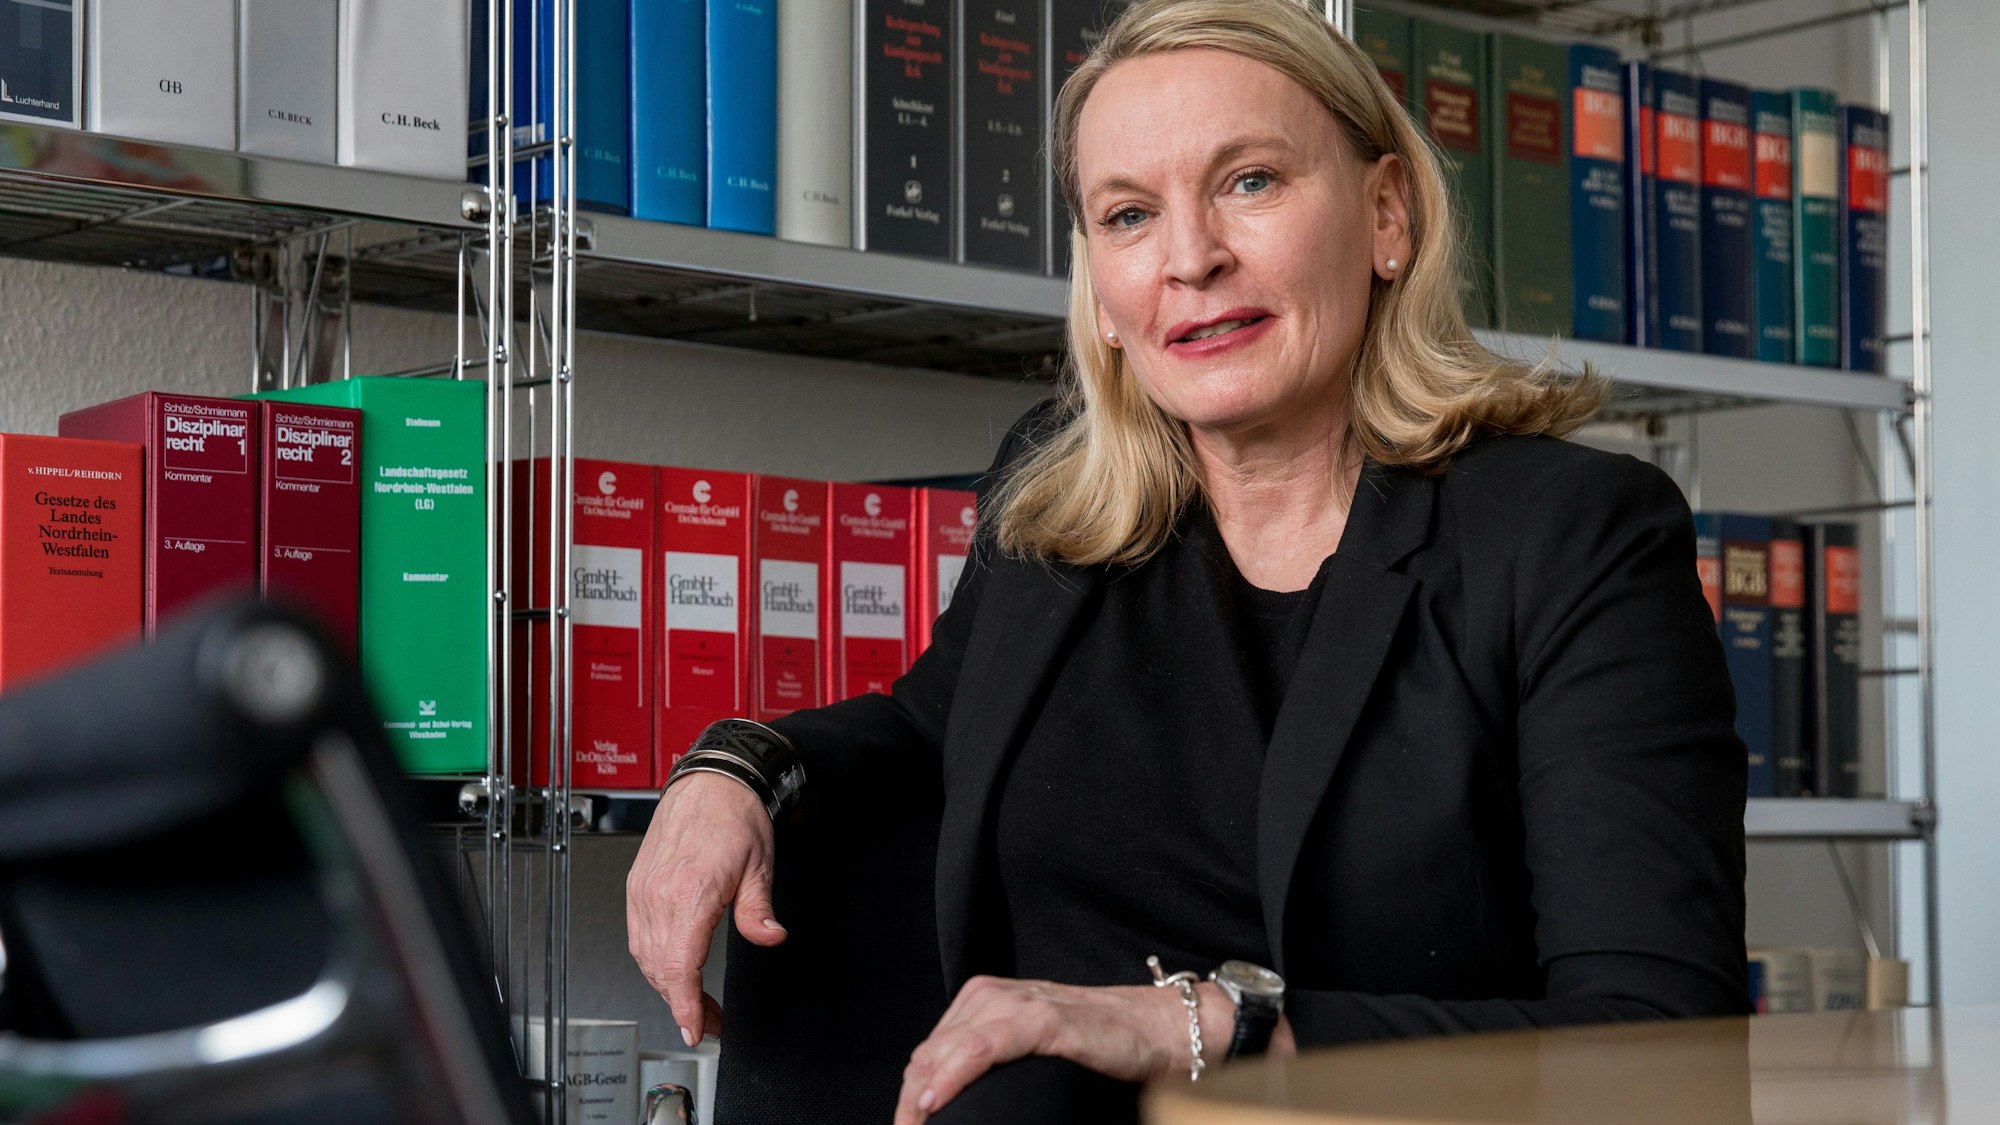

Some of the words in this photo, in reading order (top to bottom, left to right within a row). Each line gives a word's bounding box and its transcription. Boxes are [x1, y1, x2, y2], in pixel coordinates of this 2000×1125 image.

[159, 79, 182, 94] CHB
[15, 95, 60, 110] Luchterhand
[164, 403, 248, 418] Schütz/Schmiemann
[166, 416, 246, 438] Disziplinar
[275, 413, 354, 429] Schütz/Schmiemann
[277, 427, 352, 449] Disziplinar
[166, 436, 205, 453] recht
[237, 439, 246, 456] 1
[277, 446, 314, 462] recht
[341, 449, 352, 466] 2
[35, 467, 122, 480] HIPPEL/REHBORN
[165, 471, 213, 484] Kommentar
[379, 465, 468, 481] Landschaftsgesetz
[275, 481, 321, 493] Kommentar
[374, 482, 474, 495] Nordrhein-Westfalen
[35, 492, 90, 507] Gesetze
[94, 496, 116, 510] des
[415, 498, 435, 511] (LG)
[50, 509, 102, 524] Landes
[38, 525, 118, 542] Nordrhein-
[42, 542, 109, 559] Westfalen
[164, 540, 173, 549] 3.
[175, 541, 206, 553] Auflage
[274, 548, 283, 558] 3.
[284, 549, 313, 561] Auflage
[48, 567, 104, 578] Textsammlung
[403, 572, 449, 582] Kommentar
[573, 567, 623, 585] GmbH-
[669, 573, 720, 591] GmbH-
[574, 583, 638, 602] Handbuch
[671, 589, 734, 608] Handbuch
[764, 596, 815, 614] Handbuch
[844, 600, 902, 617] Handbuch
[408, 731, 447, 739] Wiesbaden
[593, 740, 618, 752] Verlag
[597, 763, 618, 775] Köln
